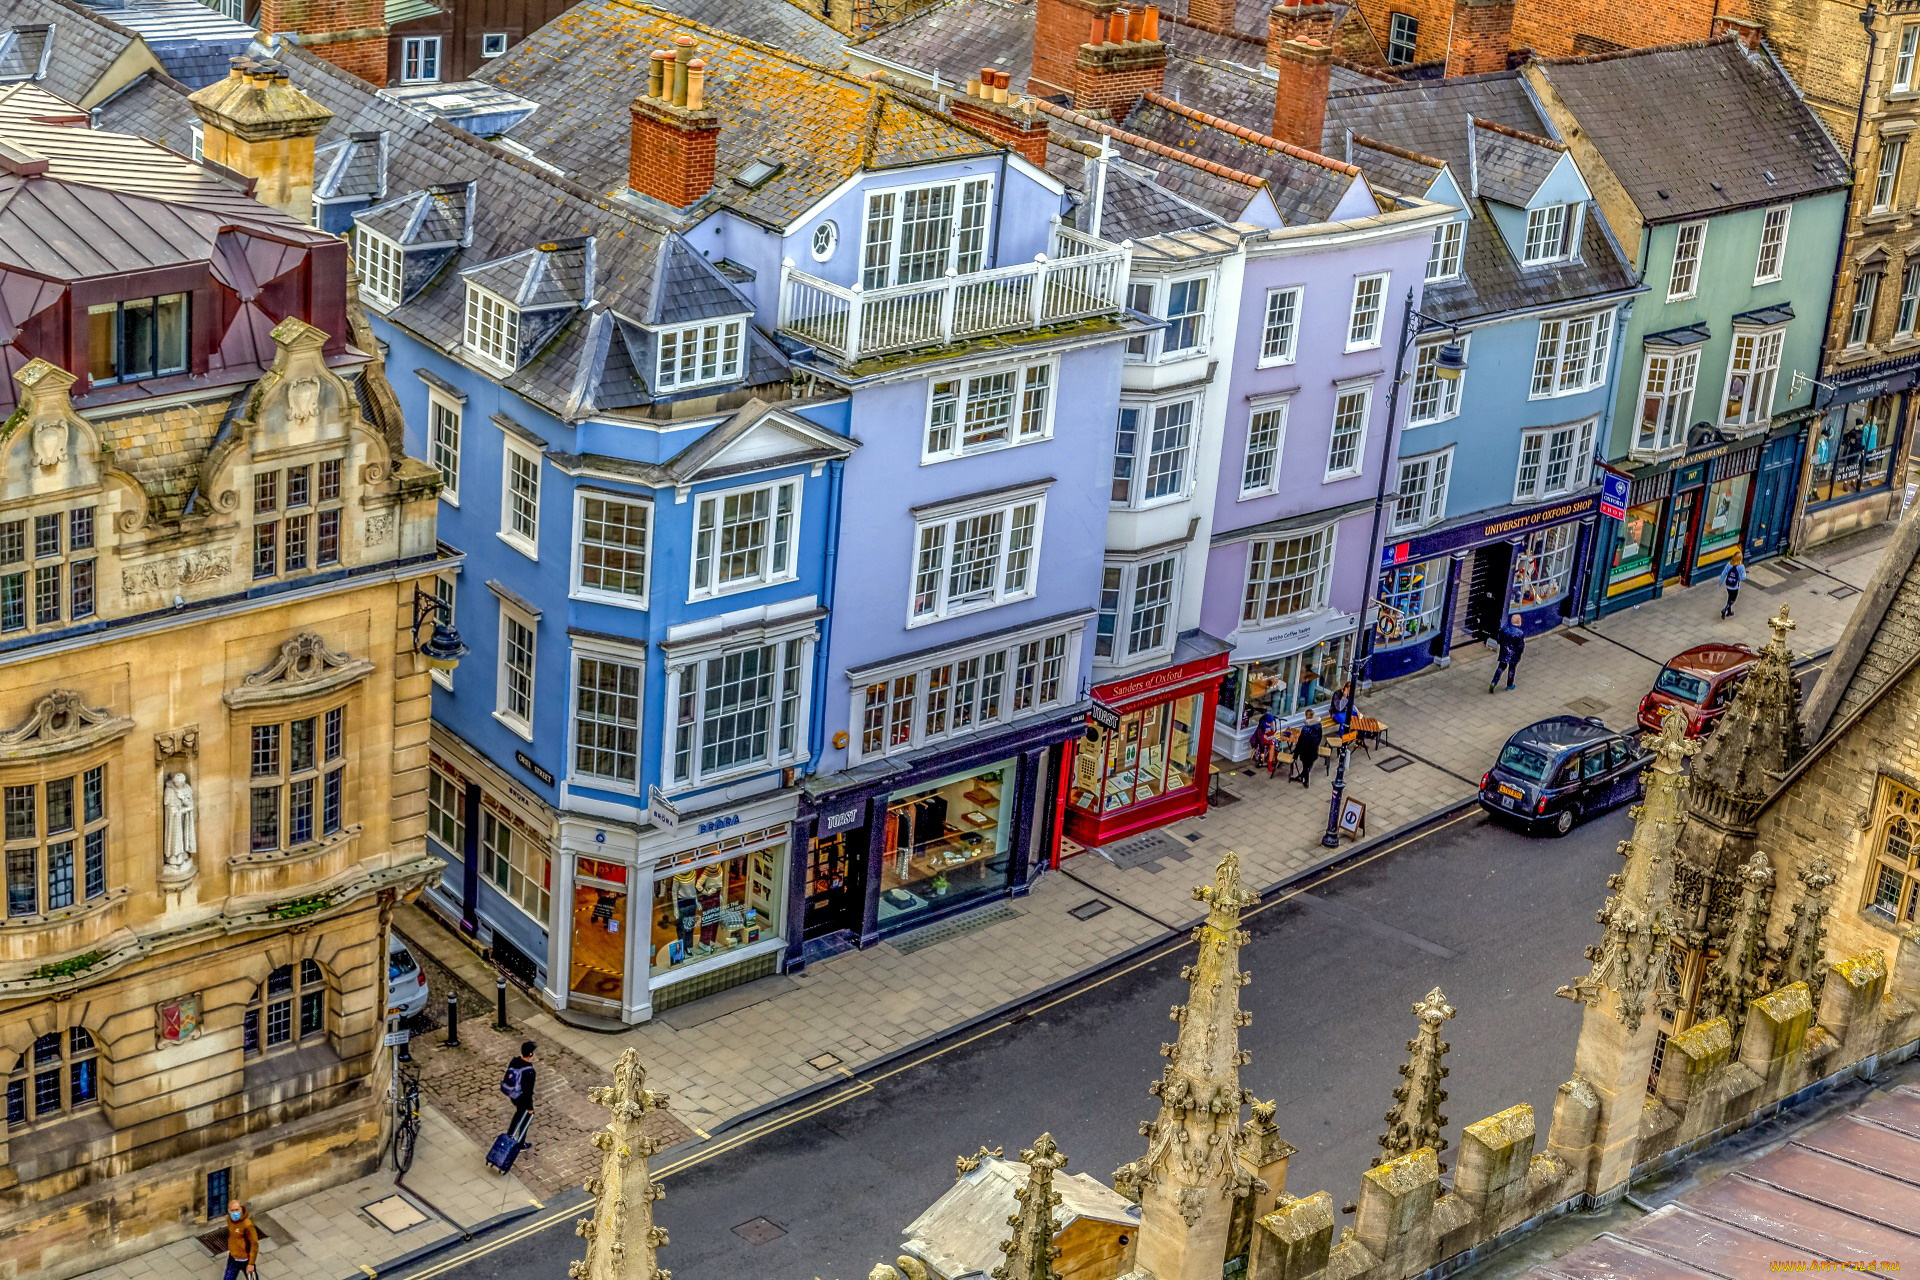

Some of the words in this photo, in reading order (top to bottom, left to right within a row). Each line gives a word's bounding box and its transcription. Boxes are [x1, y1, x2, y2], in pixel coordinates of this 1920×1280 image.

[1694, 445, 1729, 461] INSURANCE
[1602, 505, 1623, 517] SHOP
[1603, 495, 1624, 507] OXFORD
[1484, 515, 1531, 536] UNIVERSITY
[1531, 512, 1542, 523] OF
[1542, 505, 1573, 520] OXFORD
[1572, 499, 1593, 513] SHOP
[1267, 634, 1284, 643] Jericho
[1284, 630, 1298, 640] Coffee
[1112, 682, 1144, 697] Sanders
[1145, 676, 1154, 688] of
[1155, 669, 1183, 684] Oxford
[1093, 705, 1119, 729] TOAST
[518, 754, 531, 769] ORIEL
[534, 766, 552, 784] STREET
[827, 809, 858, 829] TOAST
